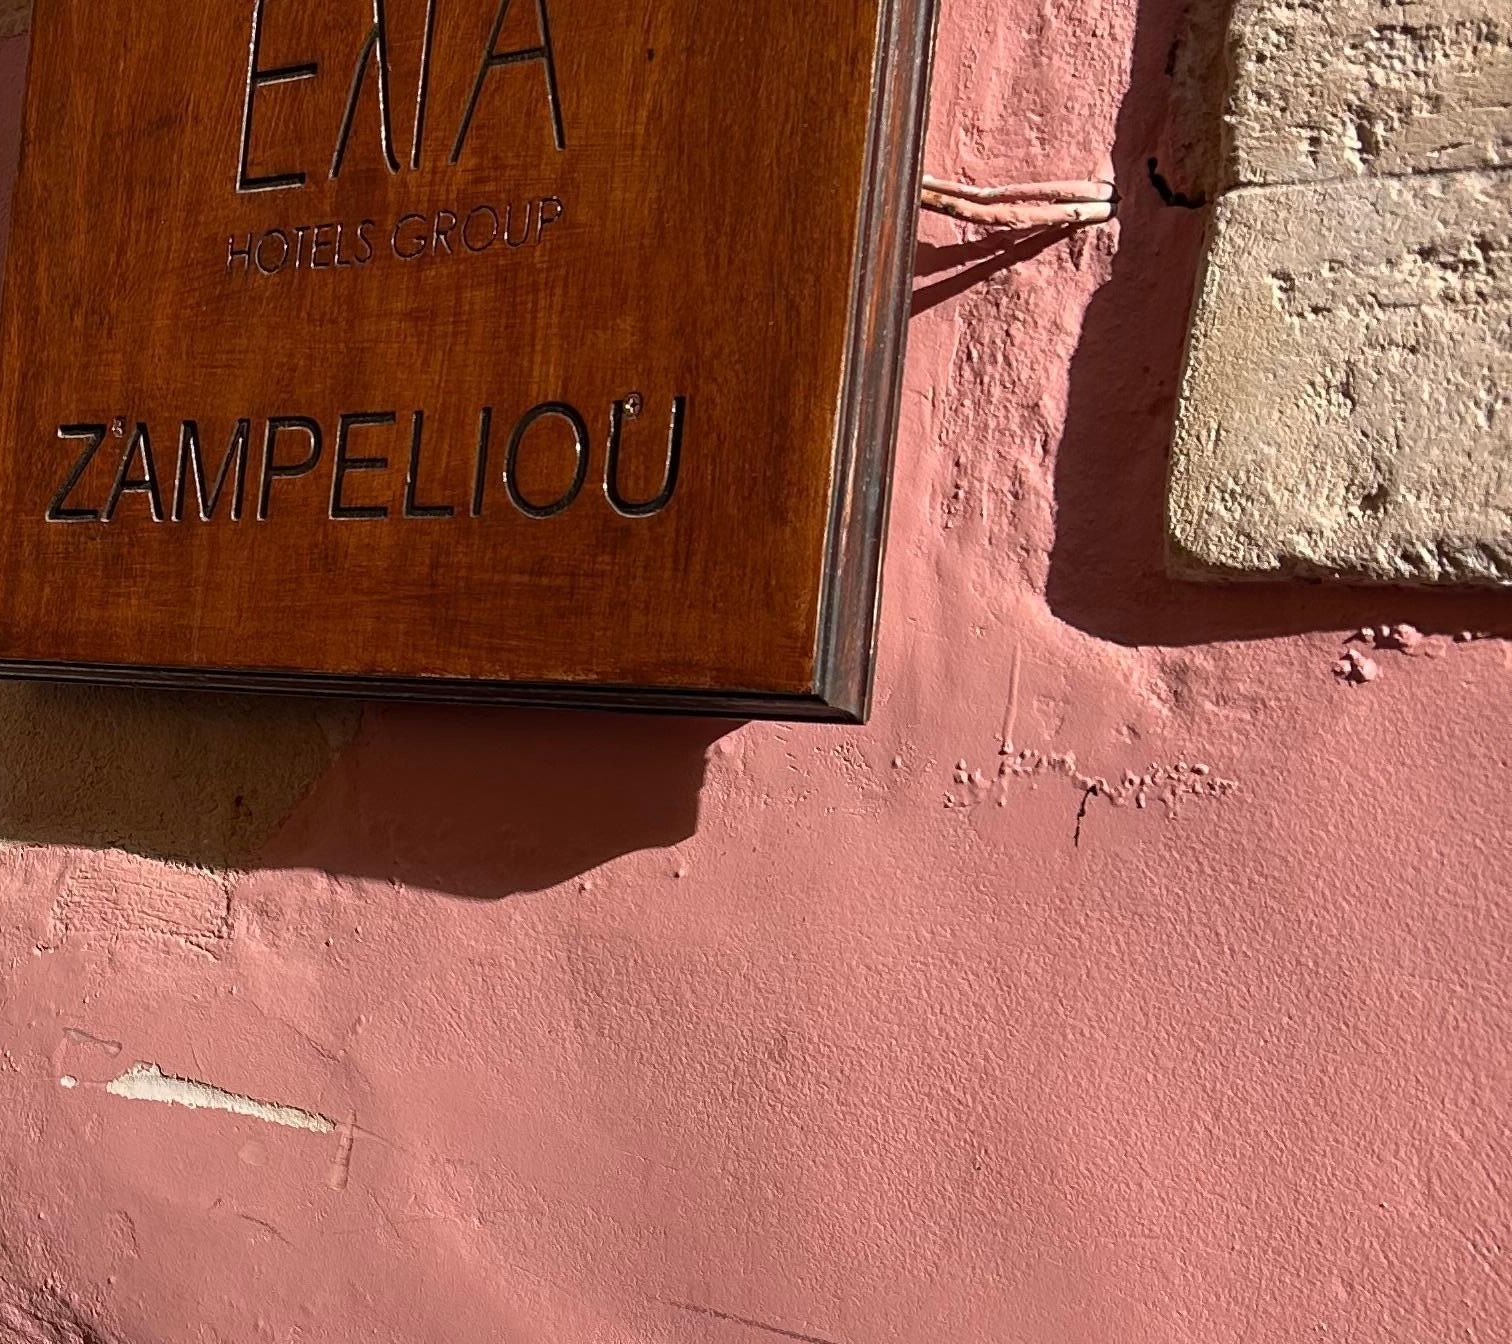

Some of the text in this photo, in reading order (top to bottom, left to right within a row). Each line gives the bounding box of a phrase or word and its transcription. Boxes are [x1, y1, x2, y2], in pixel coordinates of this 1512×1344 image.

[226, 195, 564, 275] HOTELS GROUP
[44, 395, 686, 523] ZAMPELIOU
